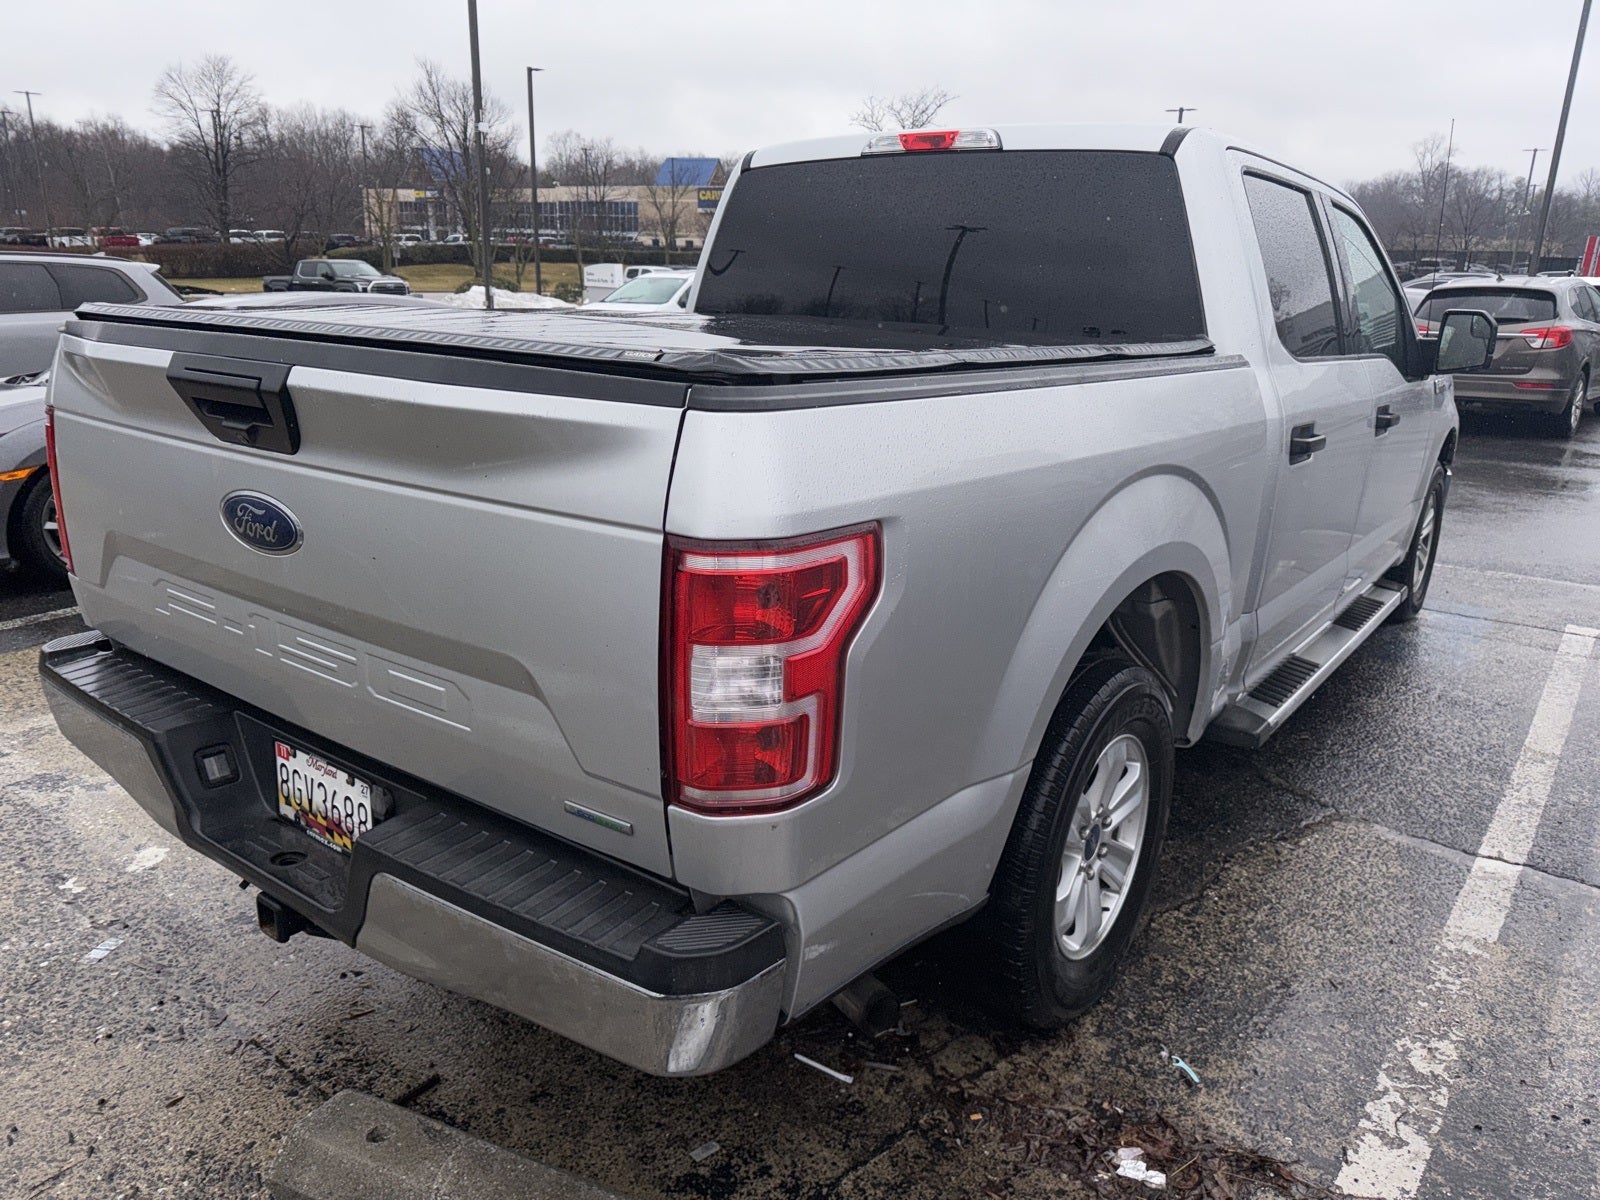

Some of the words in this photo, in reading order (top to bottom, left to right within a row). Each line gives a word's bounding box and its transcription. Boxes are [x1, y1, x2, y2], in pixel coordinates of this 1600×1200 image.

[234, 503, 278, 543] Ford
[152, 578, 472, 732] F-150
[306, 754, 338, 779] Maryland
[279, 762, 369, 836] 8GV3688
[360, 784, 369, 795] 27
